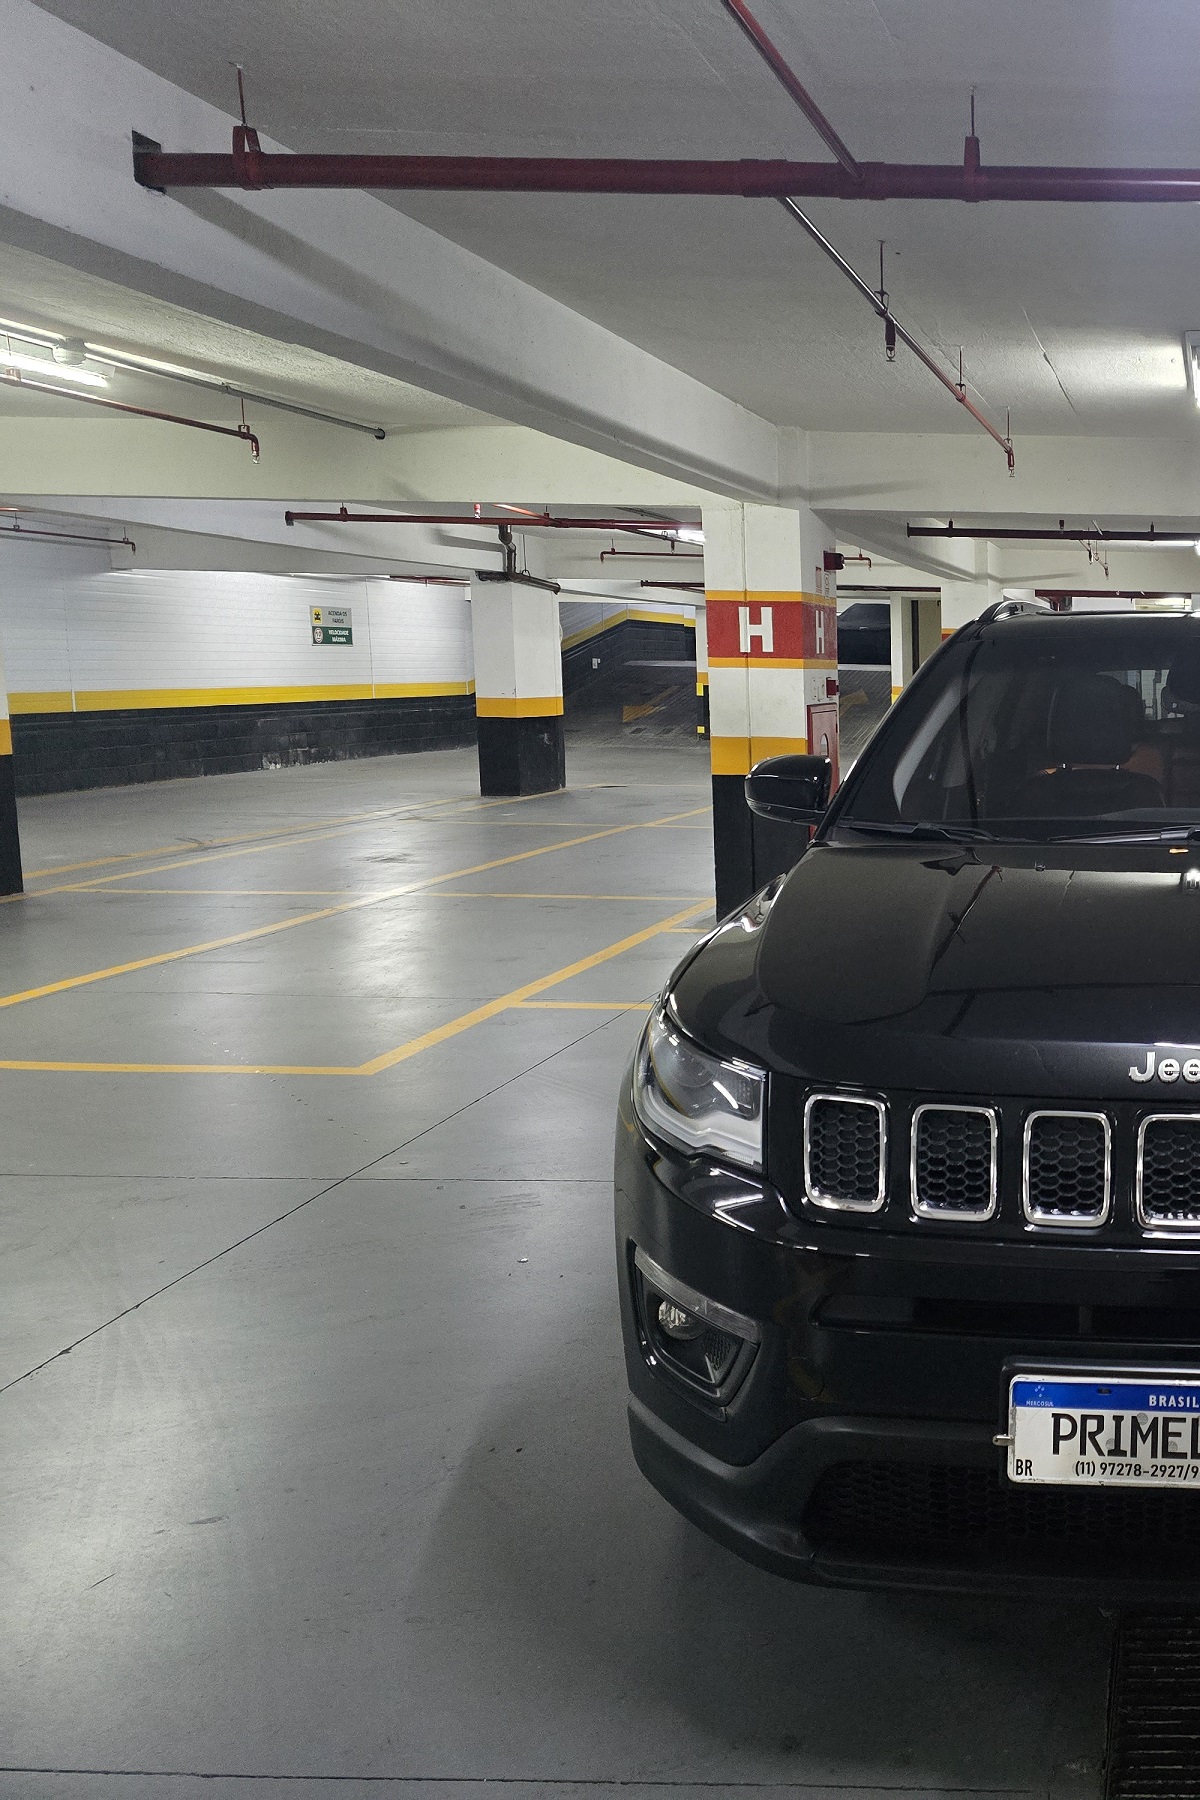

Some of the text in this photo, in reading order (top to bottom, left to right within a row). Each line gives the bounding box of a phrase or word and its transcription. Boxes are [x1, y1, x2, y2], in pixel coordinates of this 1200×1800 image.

[738, 606, 774, 653] H
[815, 609, 825, 654] H
[1149, 1395, 1199, 1408] BRASIL
[1015, 1459, 1033, 1477] BR
[1075, 1461, 1096, 1476] (11)
